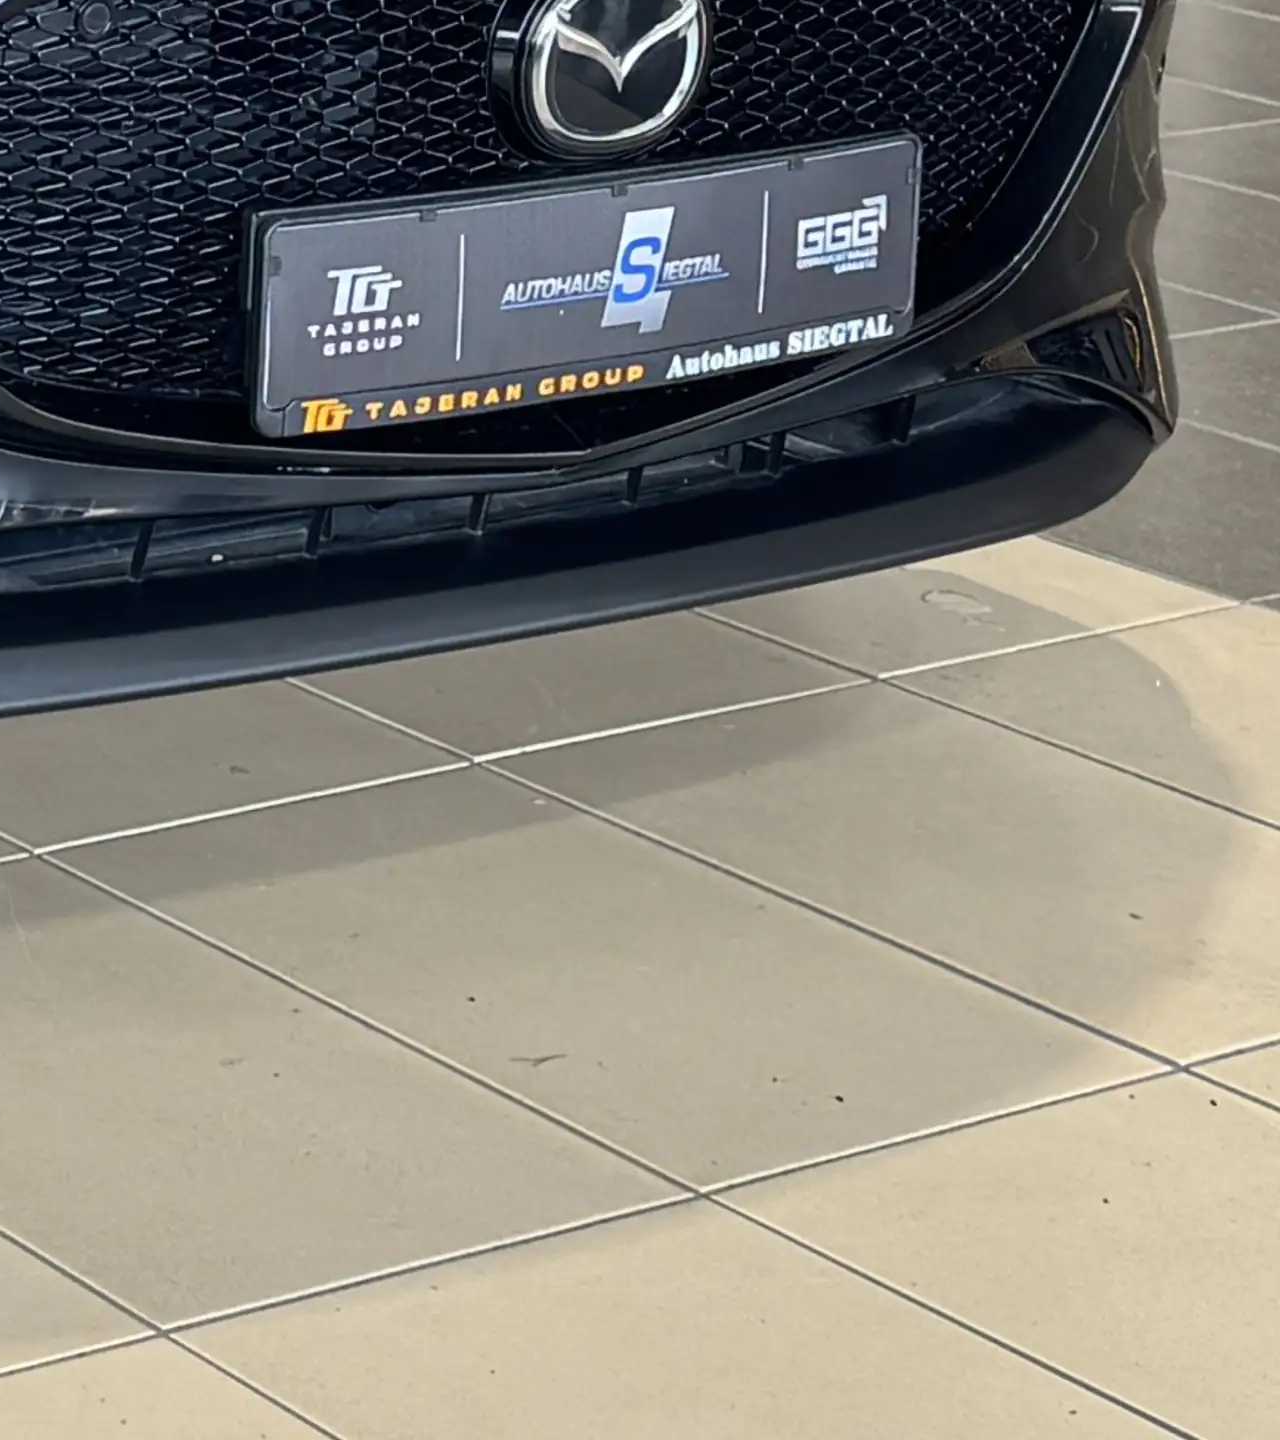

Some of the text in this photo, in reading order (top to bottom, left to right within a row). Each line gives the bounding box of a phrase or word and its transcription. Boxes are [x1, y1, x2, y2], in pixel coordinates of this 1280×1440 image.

[796, 207, 880, 258] GGG
[500, 269, 613, 306] AUTOHAUS
[323, 334, 403, 357] GROUP
[666, 313, 894, 380] Autohaus SIEGTAL
[537, 364, 645, 397] GROUP
